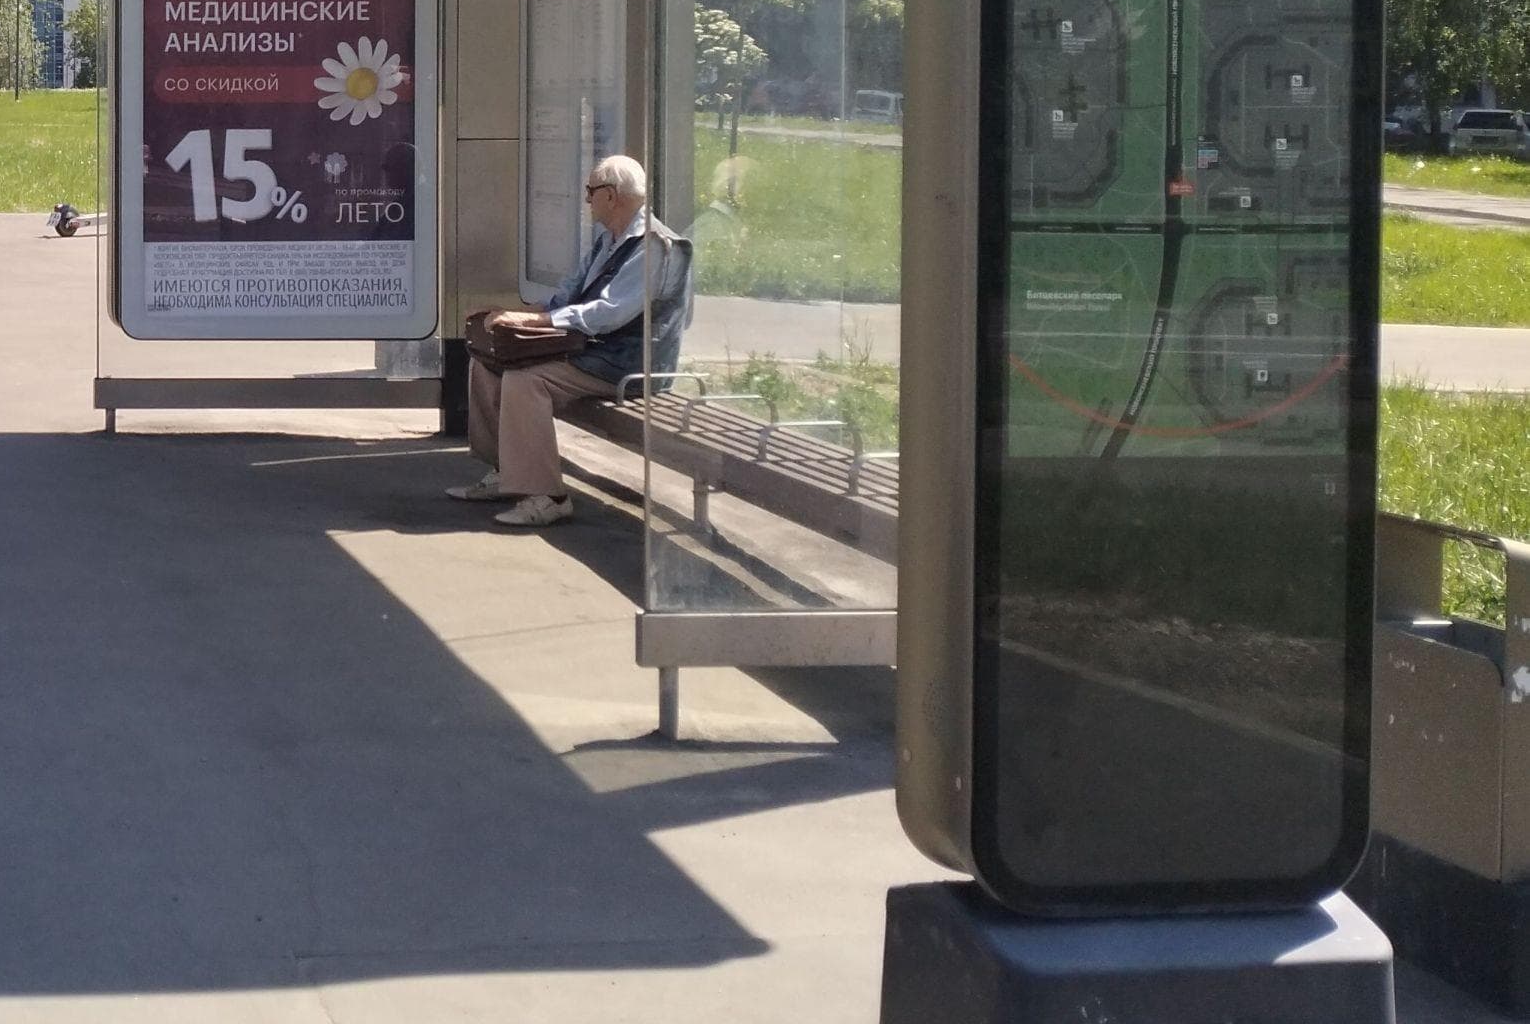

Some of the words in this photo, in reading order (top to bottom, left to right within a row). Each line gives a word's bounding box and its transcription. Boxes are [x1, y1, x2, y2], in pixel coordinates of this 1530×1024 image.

[165, 1, 371, 25] МЕДИЦИНСКИЕ
[165, 128, 309, 224] 15%
[335, 202, 405, 223] ЛЕТО
[153, 279, 231, 294] ИМЕЮТСЯ
[153, 294, 232, 311] НЕОБХОДИМА
[234, 293, 324, 309] КОНСУЛЬТАЦИЯ
[326, 293, 408, 309] СПЕЦИАЛИСТА
